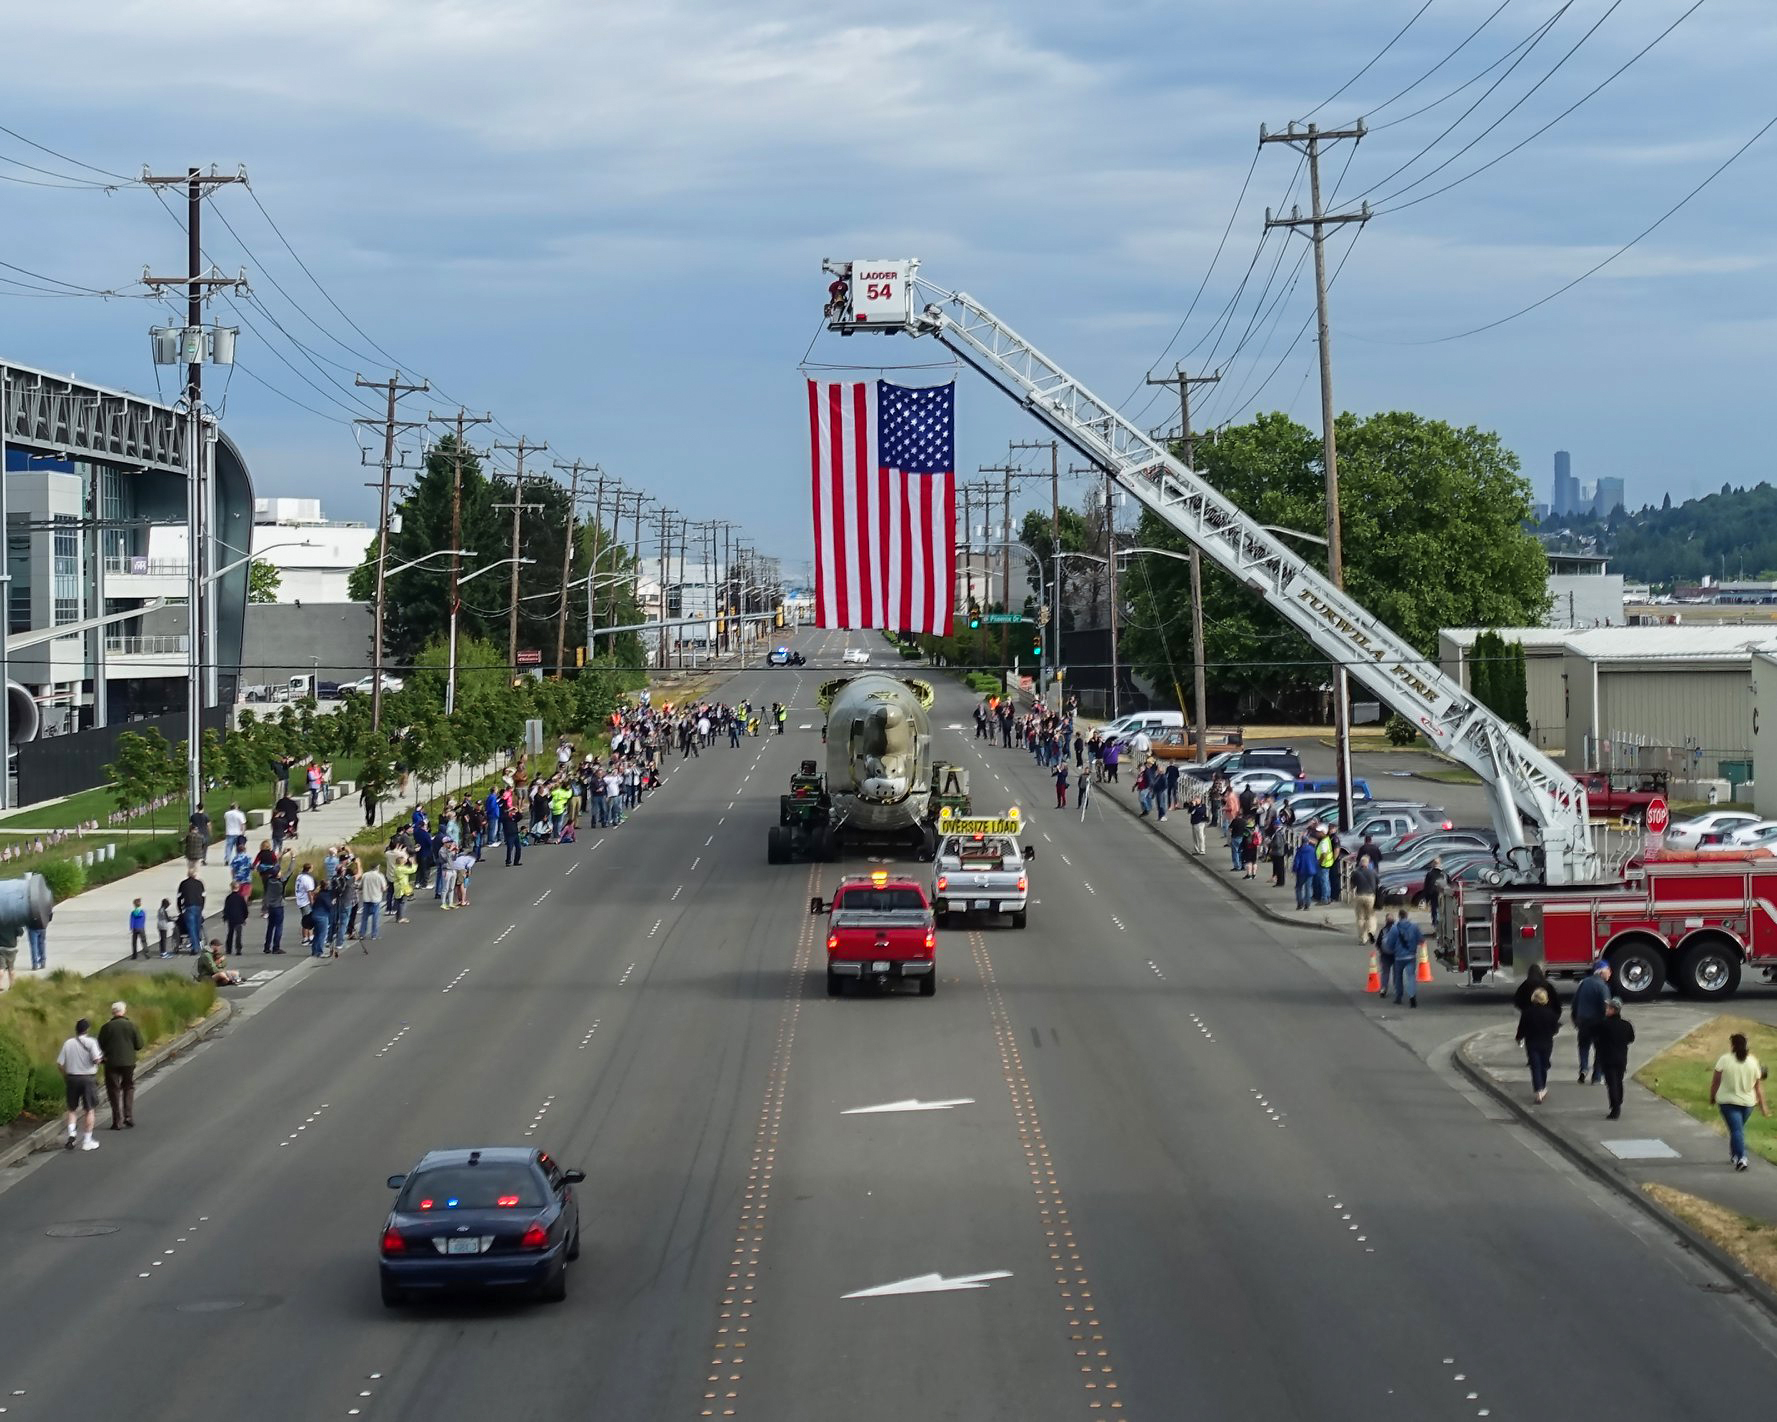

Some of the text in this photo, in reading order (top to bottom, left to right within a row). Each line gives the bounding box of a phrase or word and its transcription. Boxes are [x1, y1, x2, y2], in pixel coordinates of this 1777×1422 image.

[860, 272, 897, 280] LADDER
[867, 284, 892, 300] 54
[1298, 588, 1440, 703] TUKWILA FIRE
[1647, 809, 1666, 824] STOP
[942, 820, 1018, 833] OVERSIZE LOAD
